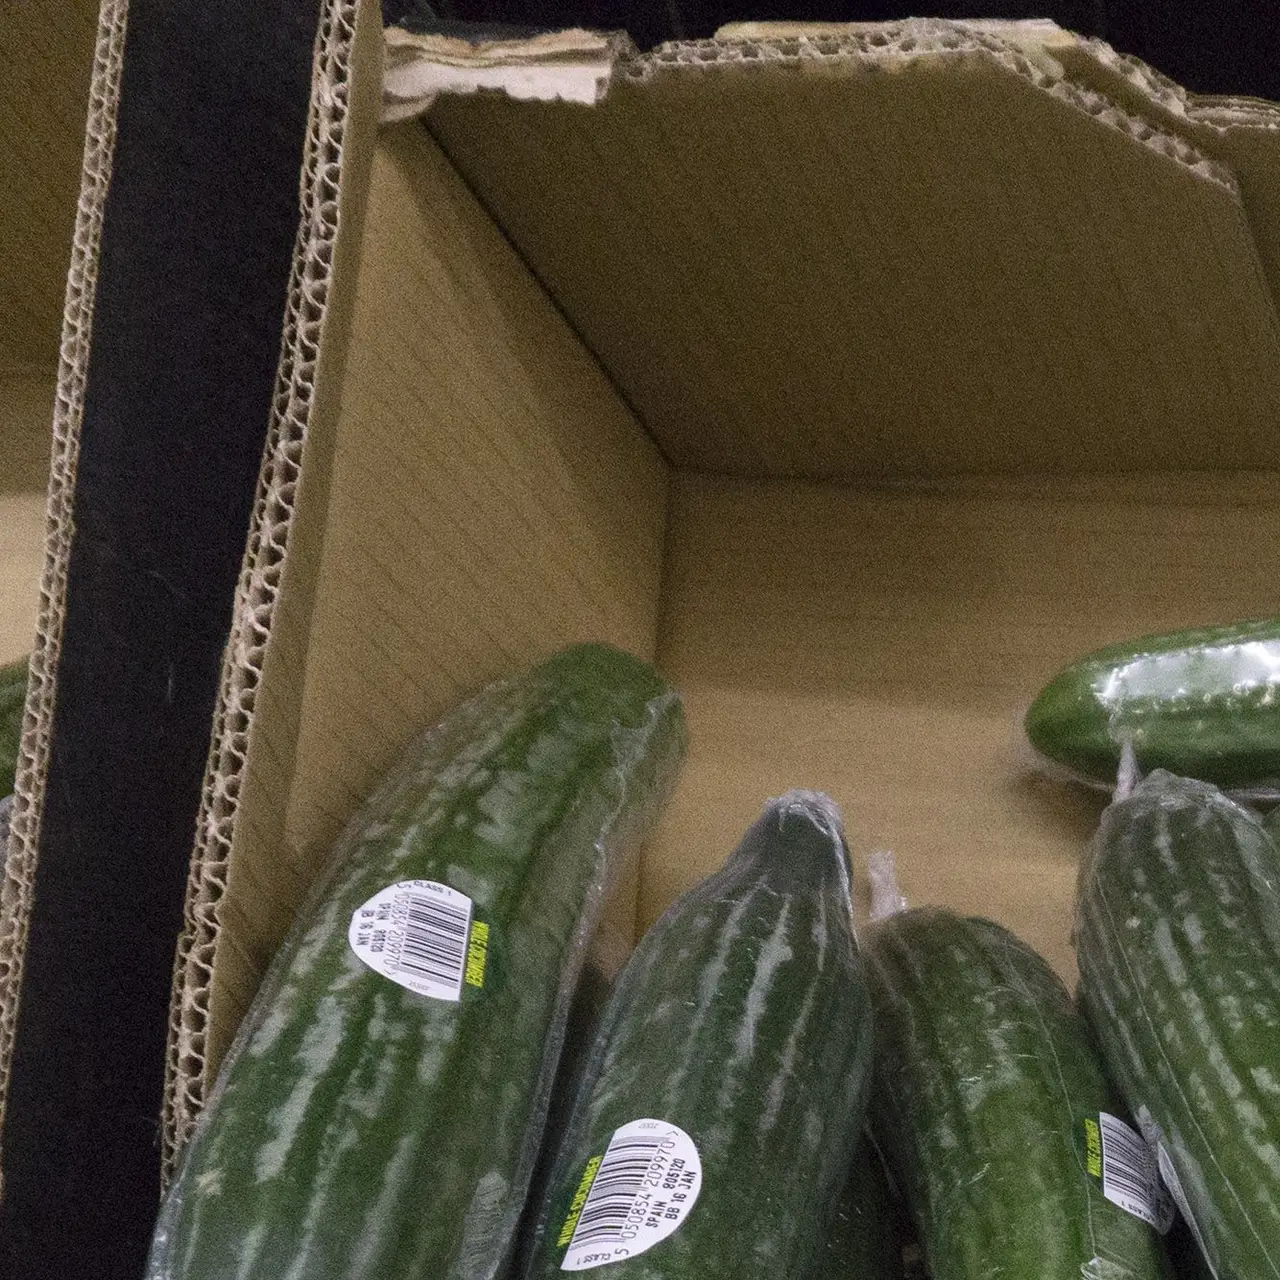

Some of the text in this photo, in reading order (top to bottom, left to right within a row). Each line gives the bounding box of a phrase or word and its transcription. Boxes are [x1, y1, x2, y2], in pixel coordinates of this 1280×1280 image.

[644, 1141, 677, 1188] 209970
[664, 1170, 697, 1220] BB 16 JAN
[620, 1193, 652, 1240] 050854
[645, 1201, 668, 1229] SPAIN
[583, 1252, 611, 1264] CLASS
[614, 1248, 630, 1256] 5
